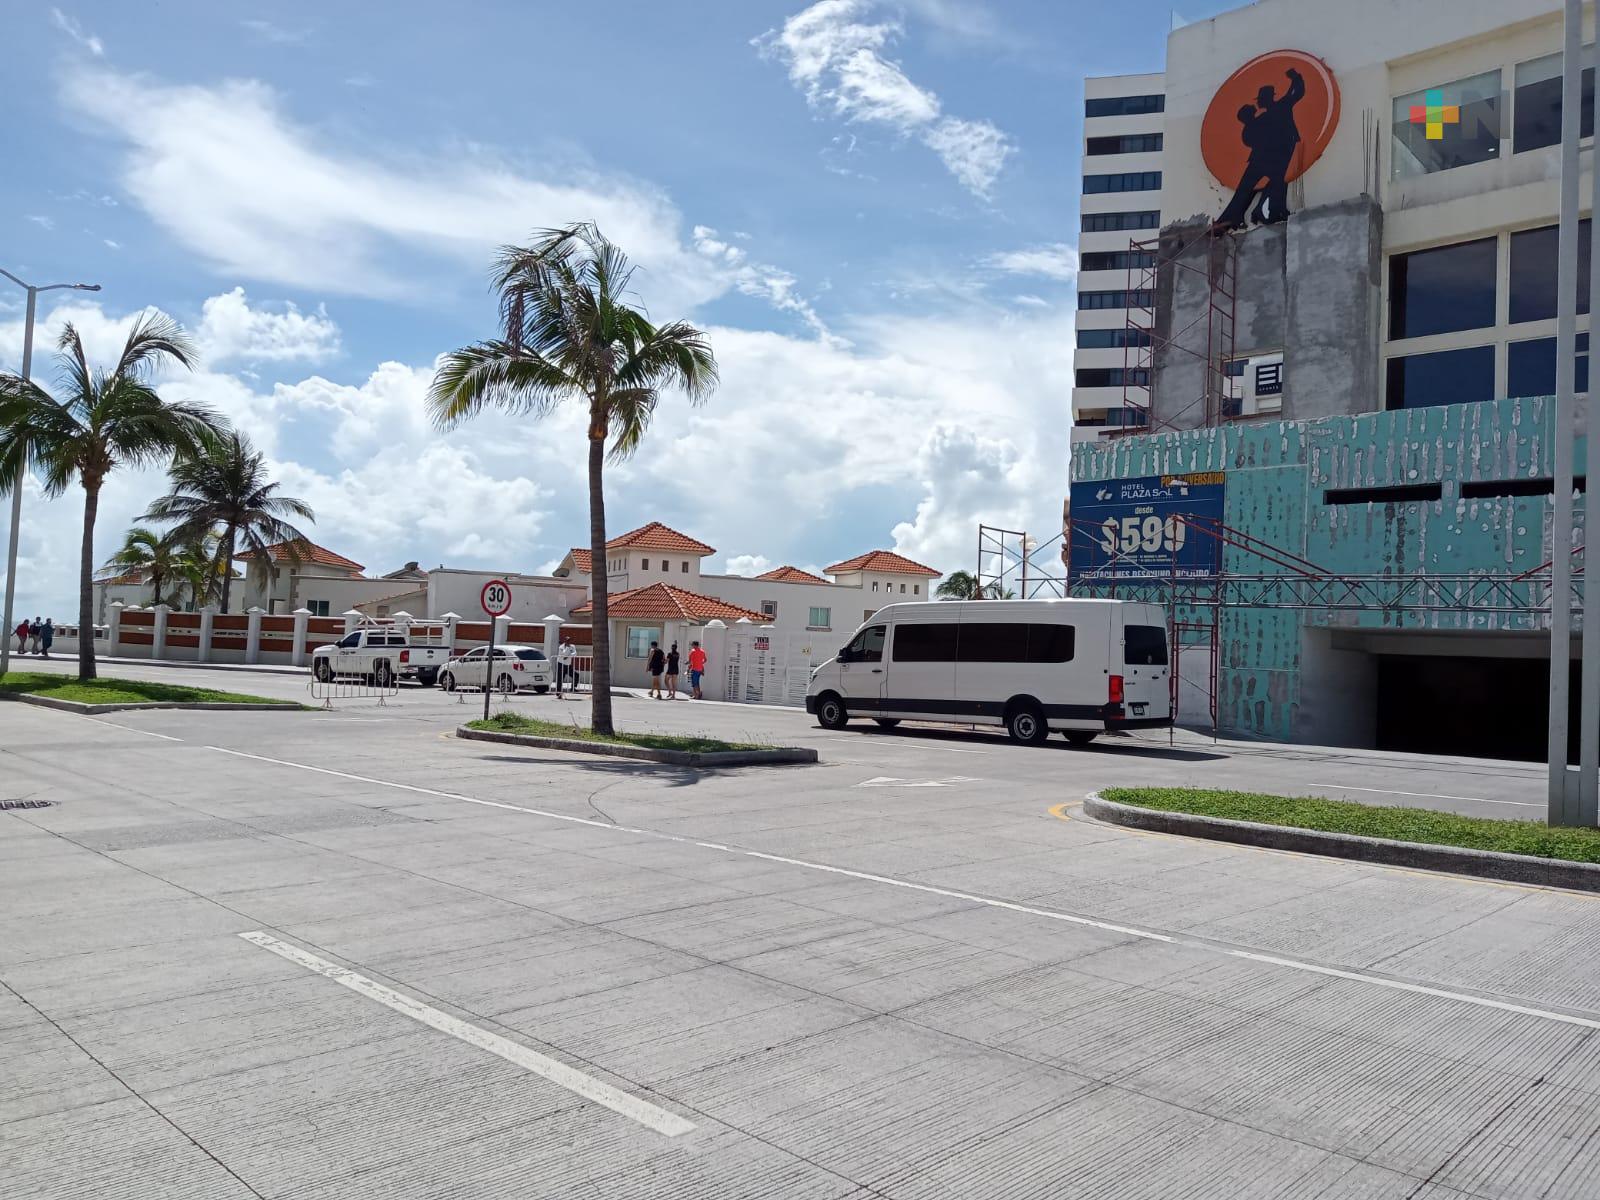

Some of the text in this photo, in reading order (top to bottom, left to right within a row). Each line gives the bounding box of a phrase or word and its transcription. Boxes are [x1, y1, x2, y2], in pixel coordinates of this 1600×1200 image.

[1176, 472, 1225, 486] IVERSARIO
[1121, 489, 1151, 499] PLAZA
[1135, 506, 1153, 514] desde
[1101, 515, 1185, 555] $599
[489, 587, 504, 602] 30
